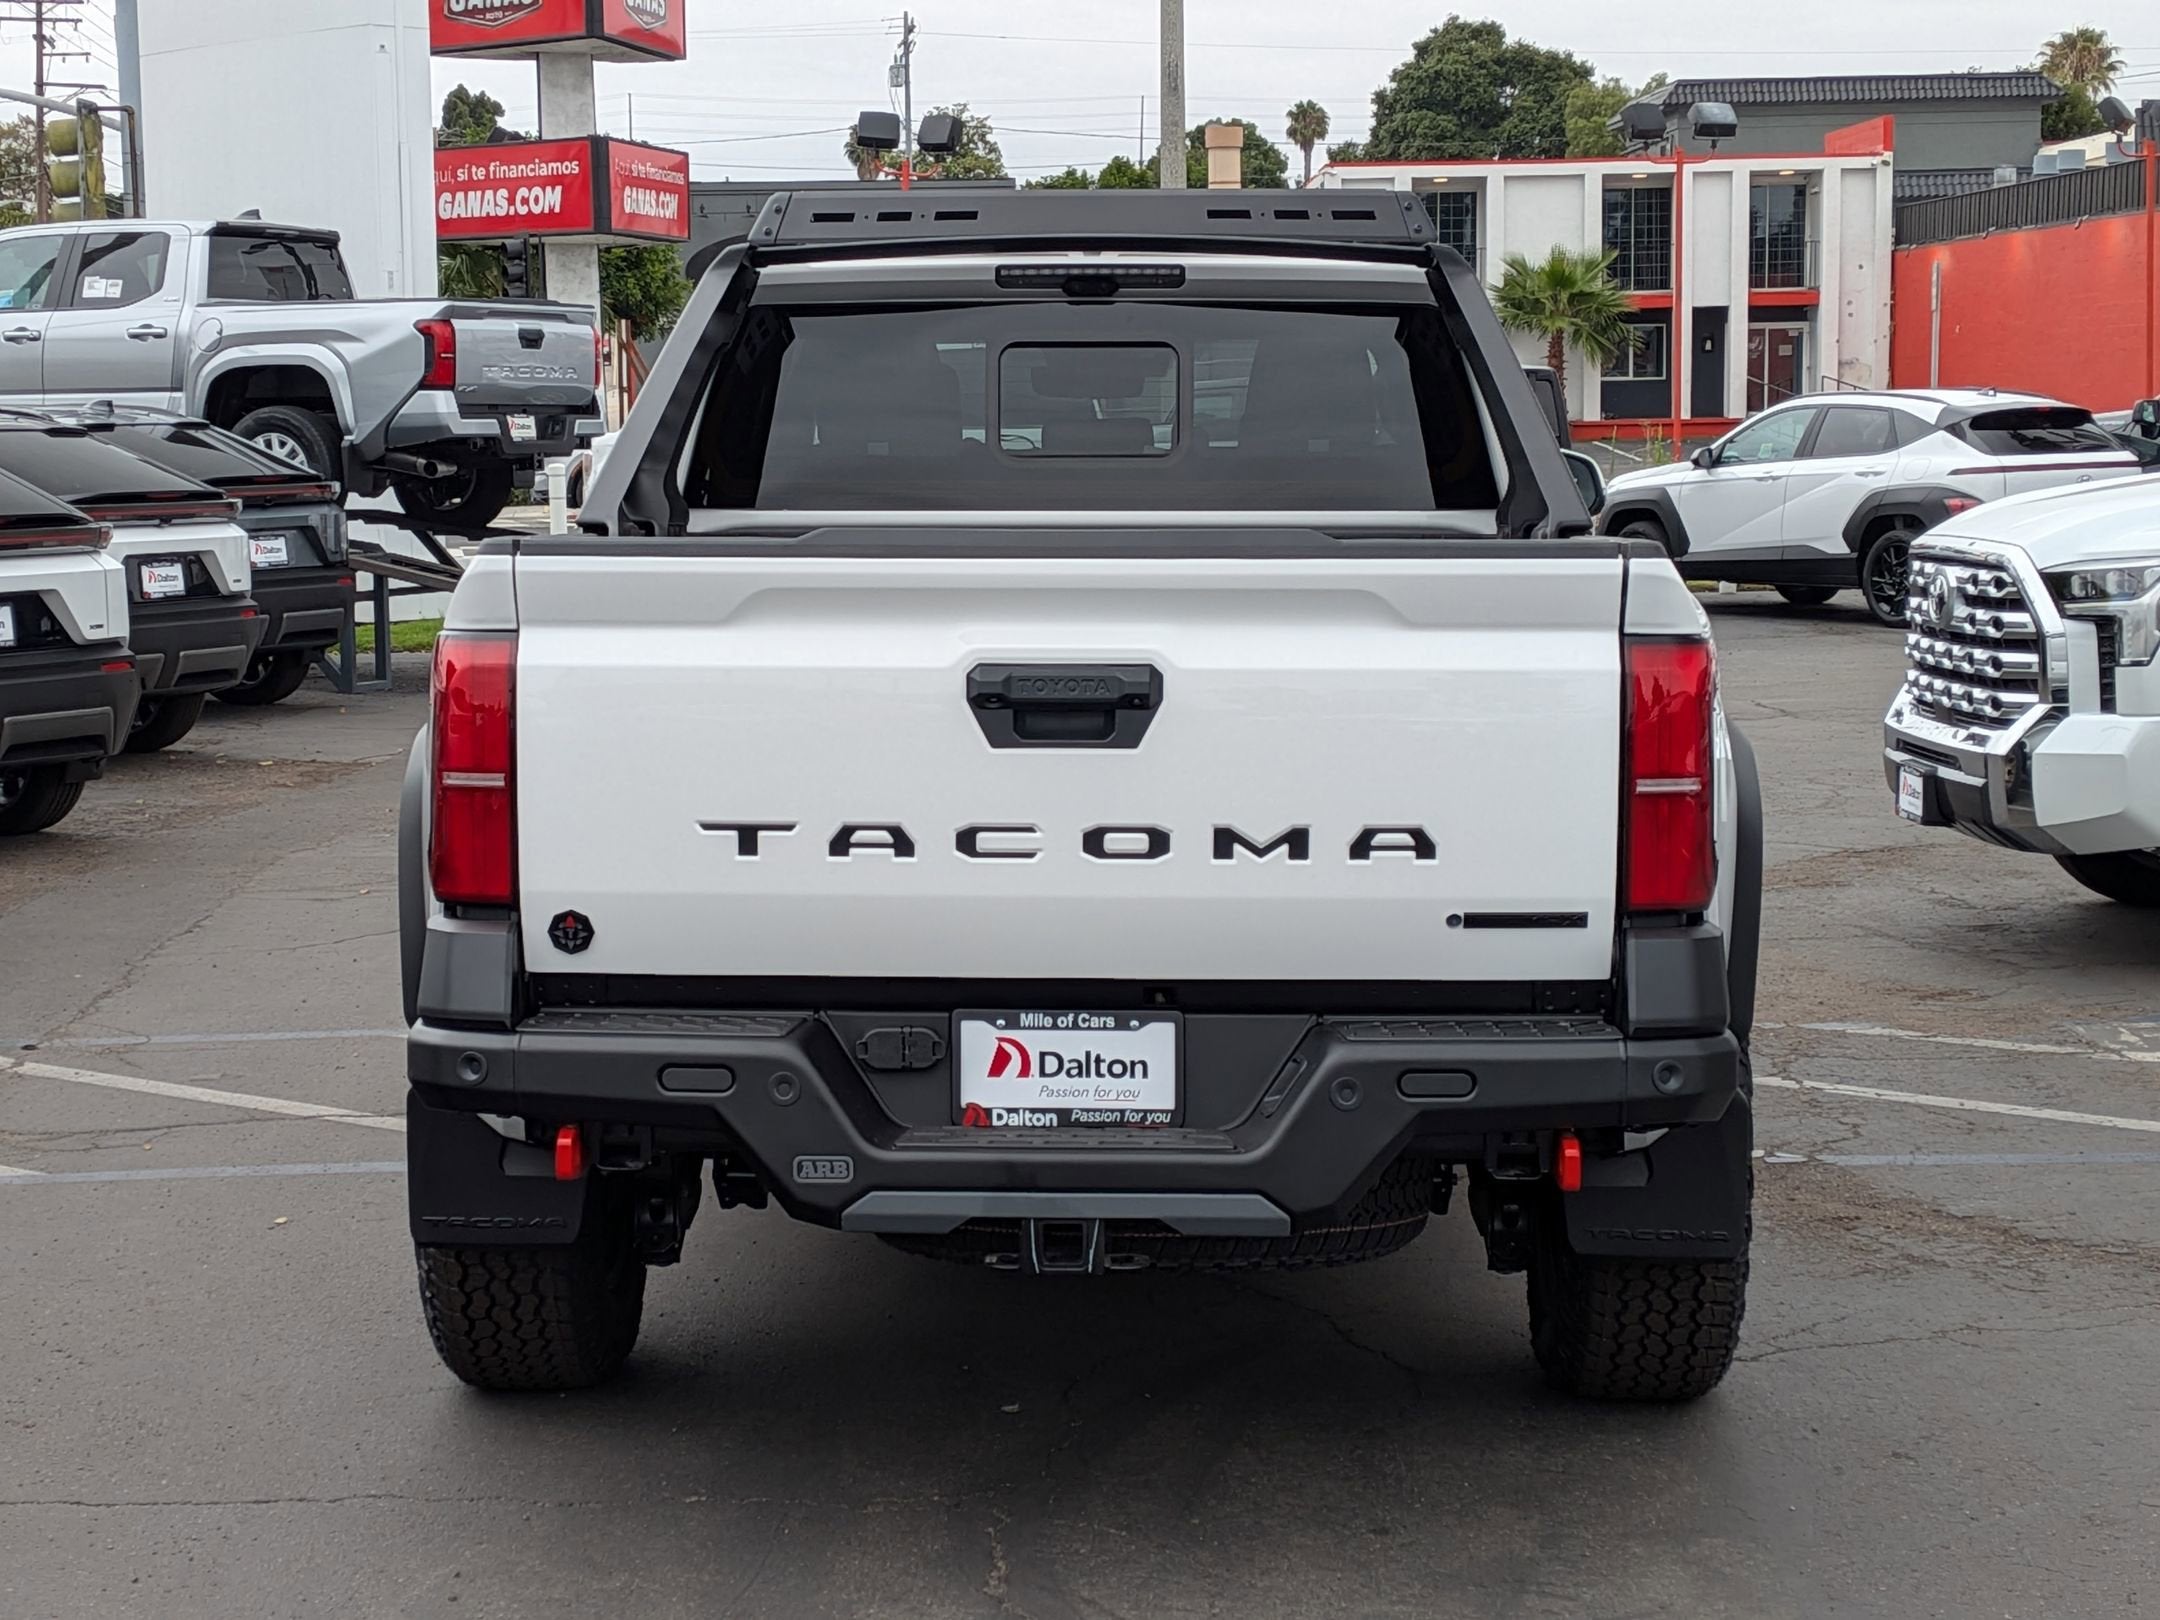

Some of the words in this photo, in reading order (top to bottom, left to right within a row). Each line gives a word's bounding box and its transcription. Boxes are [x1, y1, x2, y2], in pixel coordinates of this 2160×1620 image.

[456, 163, 469, 181] sí
[471, 165, 486, 180] te
[489, 158, 580, 179] financiamos
[438, 185, 562, 220] GANAS.COM
[623, 185, 679, 220] GANAS.COM
[481, 364, 578, 379] TACOMA
[157, 573, 179, 582] Dalton
[1017, 678, 1111, 696] TOYOTA
[695, 820, 1438, 865] TACOMA
[1019, 1013, 1053, 1028] Mile
[1057, 1013, 1075, 1028] of
[1078, 1013, 1116, 1028] Cars
[1038, 1051, 1148, 1079] Dalton
[1038, 1085, 1090, 1098] Passion
[1093, 1084, 1113, 1098] for
[1115, 1088, 1141, 1101] you
[992, 1108, 1058, 1127] Dalton
[1070, 1108, 1121, 1123] Passion
[1123, 1109, 1144, 1123] for
[1144, 1112, 1172, 1125] you
[799, 1161, 848, 1178] ARB
